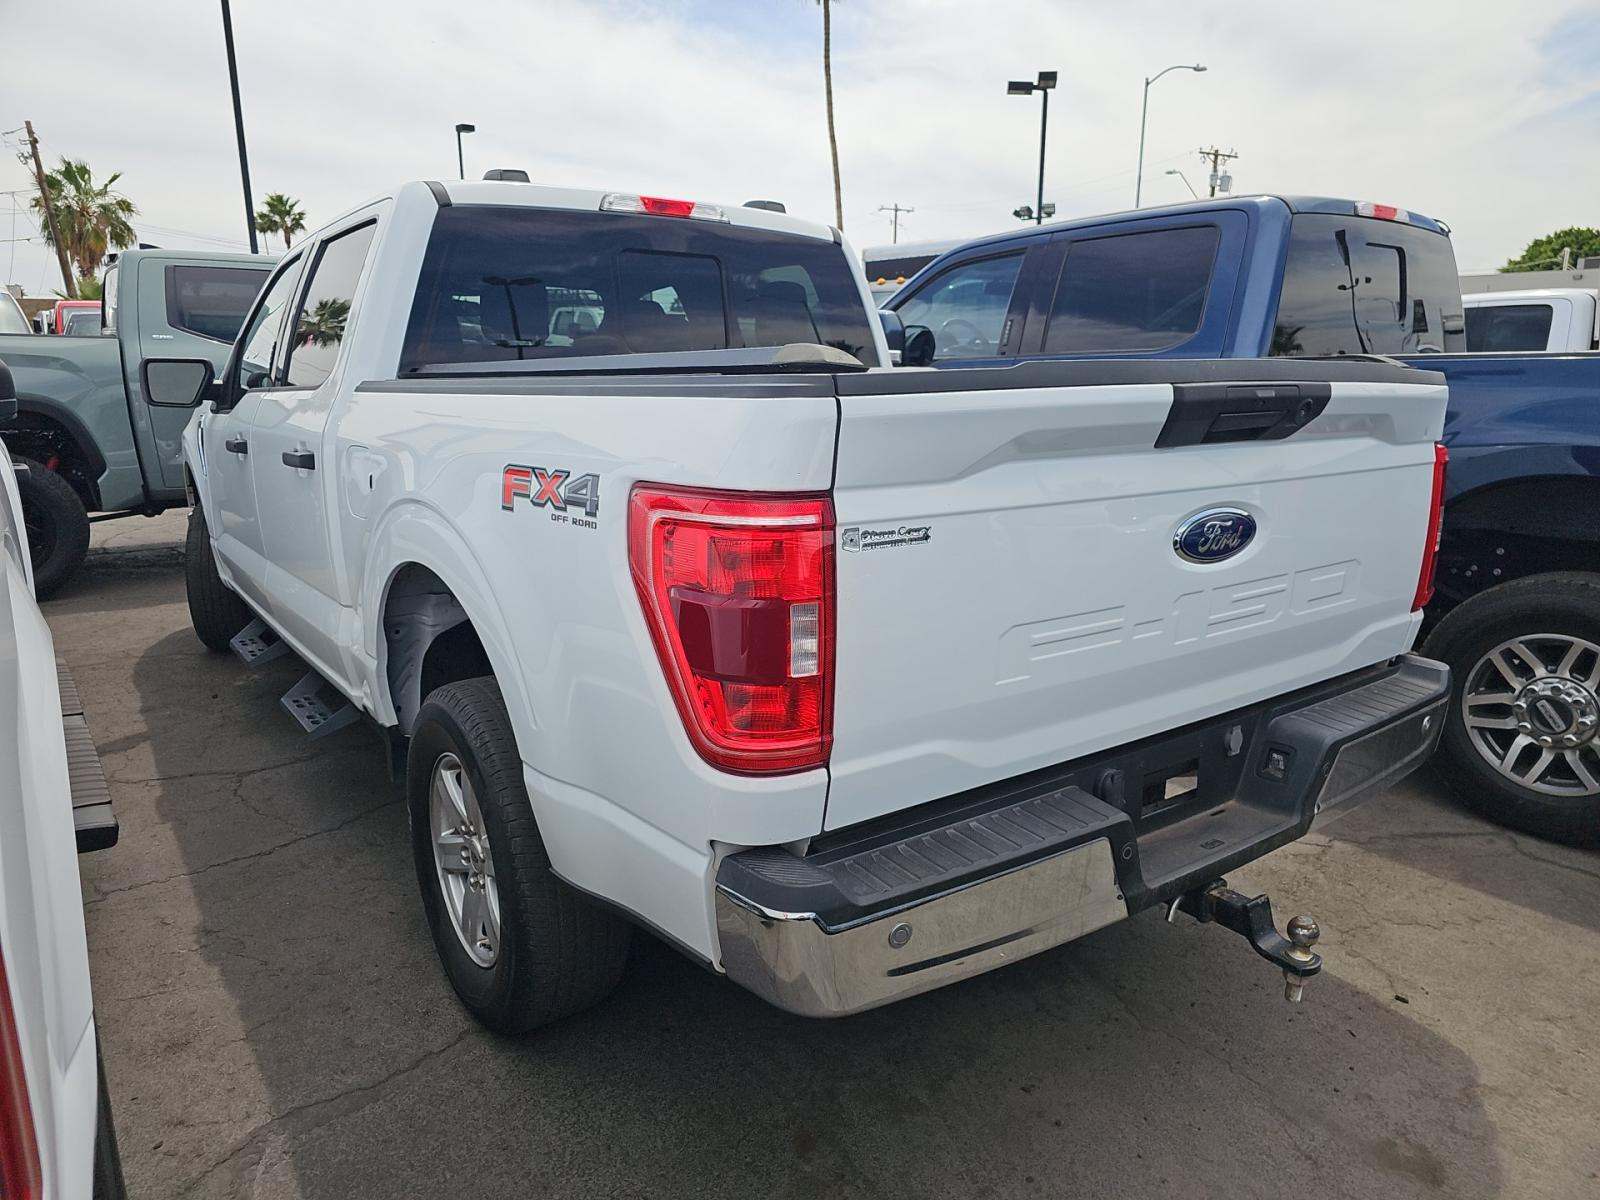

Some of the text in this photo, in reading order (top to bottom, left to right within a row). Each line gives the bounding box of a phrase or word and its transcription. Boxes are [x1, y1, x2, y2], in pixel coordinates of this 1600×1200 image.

[502, 463, 600, 517] FX4
[551, 513, 598, 530] OFF ROAD
[1198, 520, 1243, 553] Ford
[995, 559, 1362, 685] F-150
